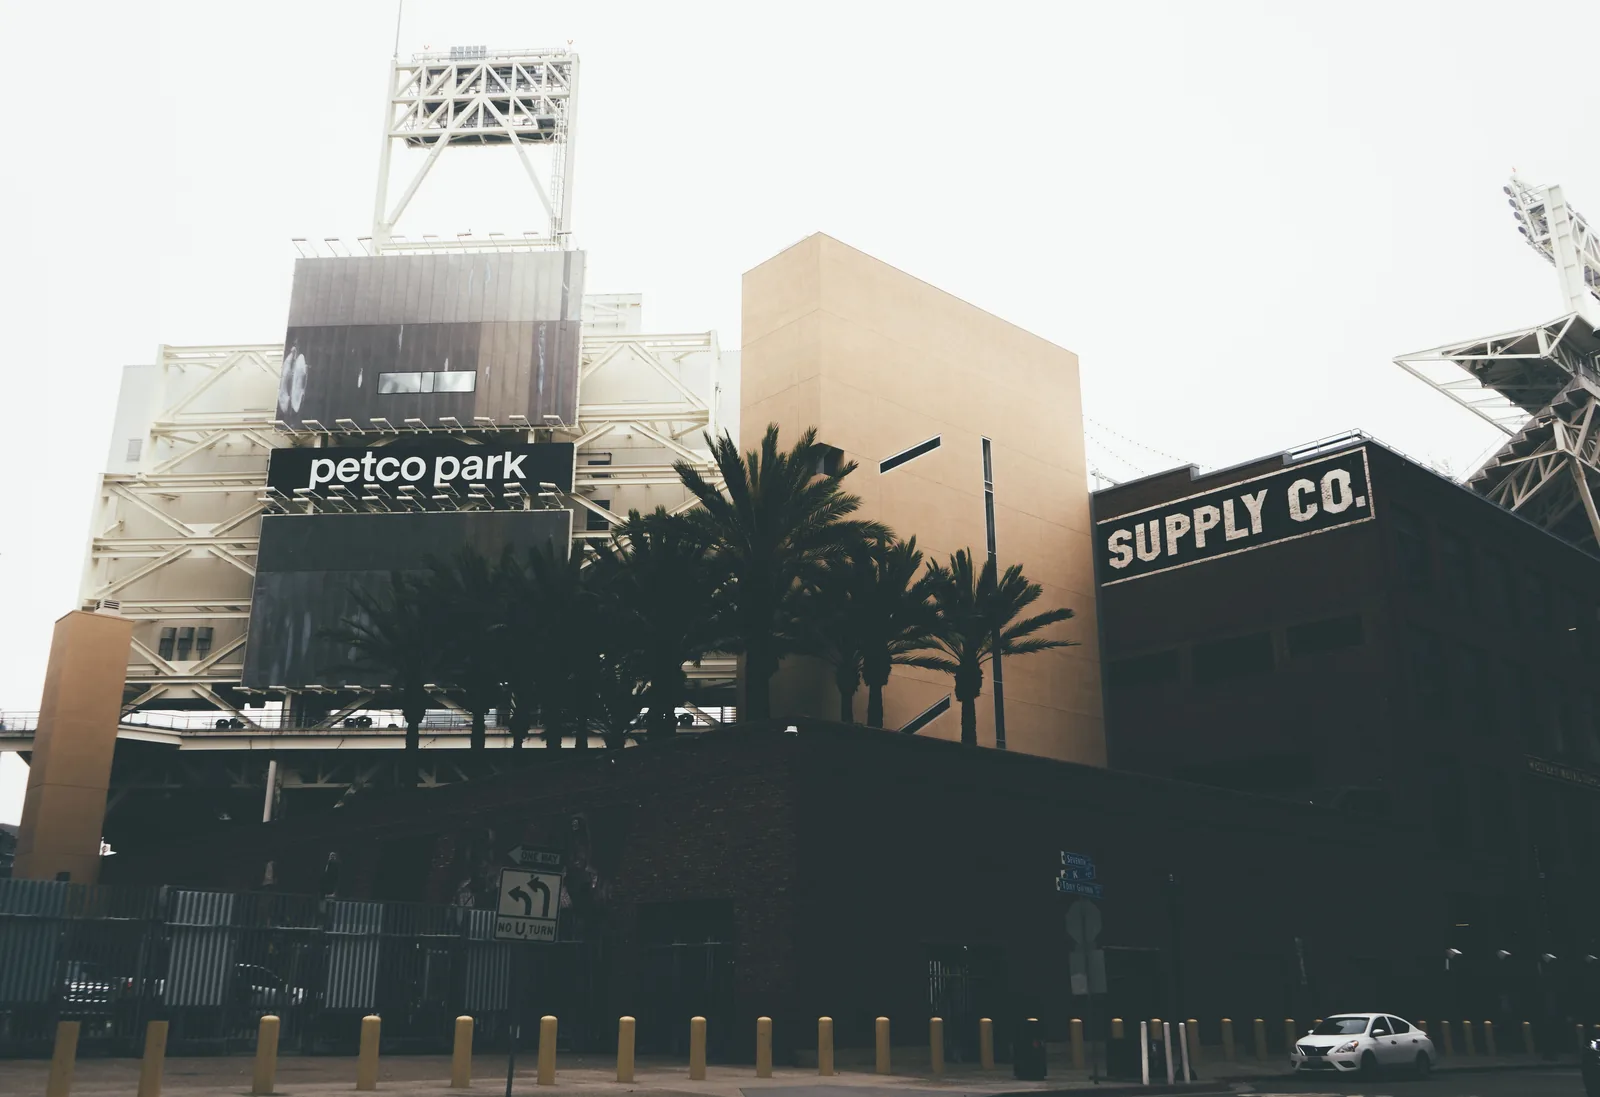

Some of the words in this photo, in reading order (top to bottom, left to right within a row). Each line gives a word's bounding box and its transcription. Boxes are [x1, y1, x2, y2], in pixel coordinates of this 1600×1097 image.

[309, 451, 426, 490] petco
[434, 451, 528, 488] park
[1108, 489, 1268, 569] SUPPLY
[1287, 468, 1366, 522] CO.
[521, 851, 538, 861] ONE
[541, 853, 558, 863] WAY
[1072, 869, 1078, 879] K
[498, 922, 512, 933] NO
[515, 922, 526, 935] U
[529, 924, 554, 936] TURN
